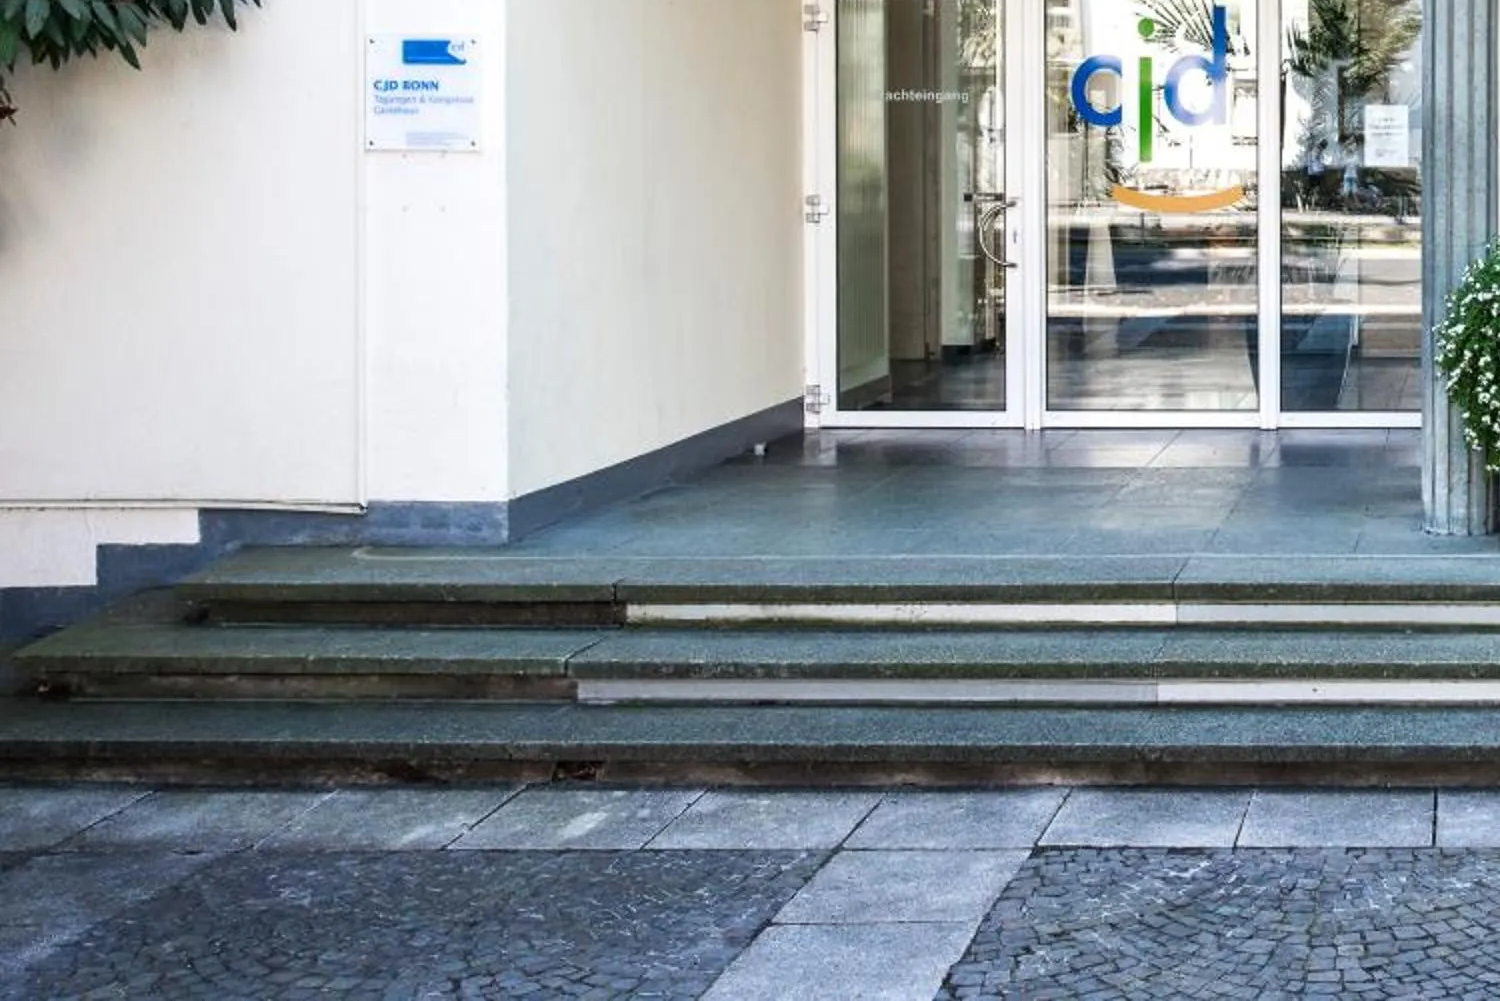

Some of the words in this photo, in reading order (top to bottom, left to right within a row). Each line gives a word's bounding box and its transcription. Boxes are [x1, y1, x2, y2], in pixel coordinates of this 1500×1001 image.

[373, 79, 399, 92] CJD
[402, 79, 439, 92] BONN
[1070, 4, 1227, 163] cjd
[875, 89, 969, 104] achteingang
